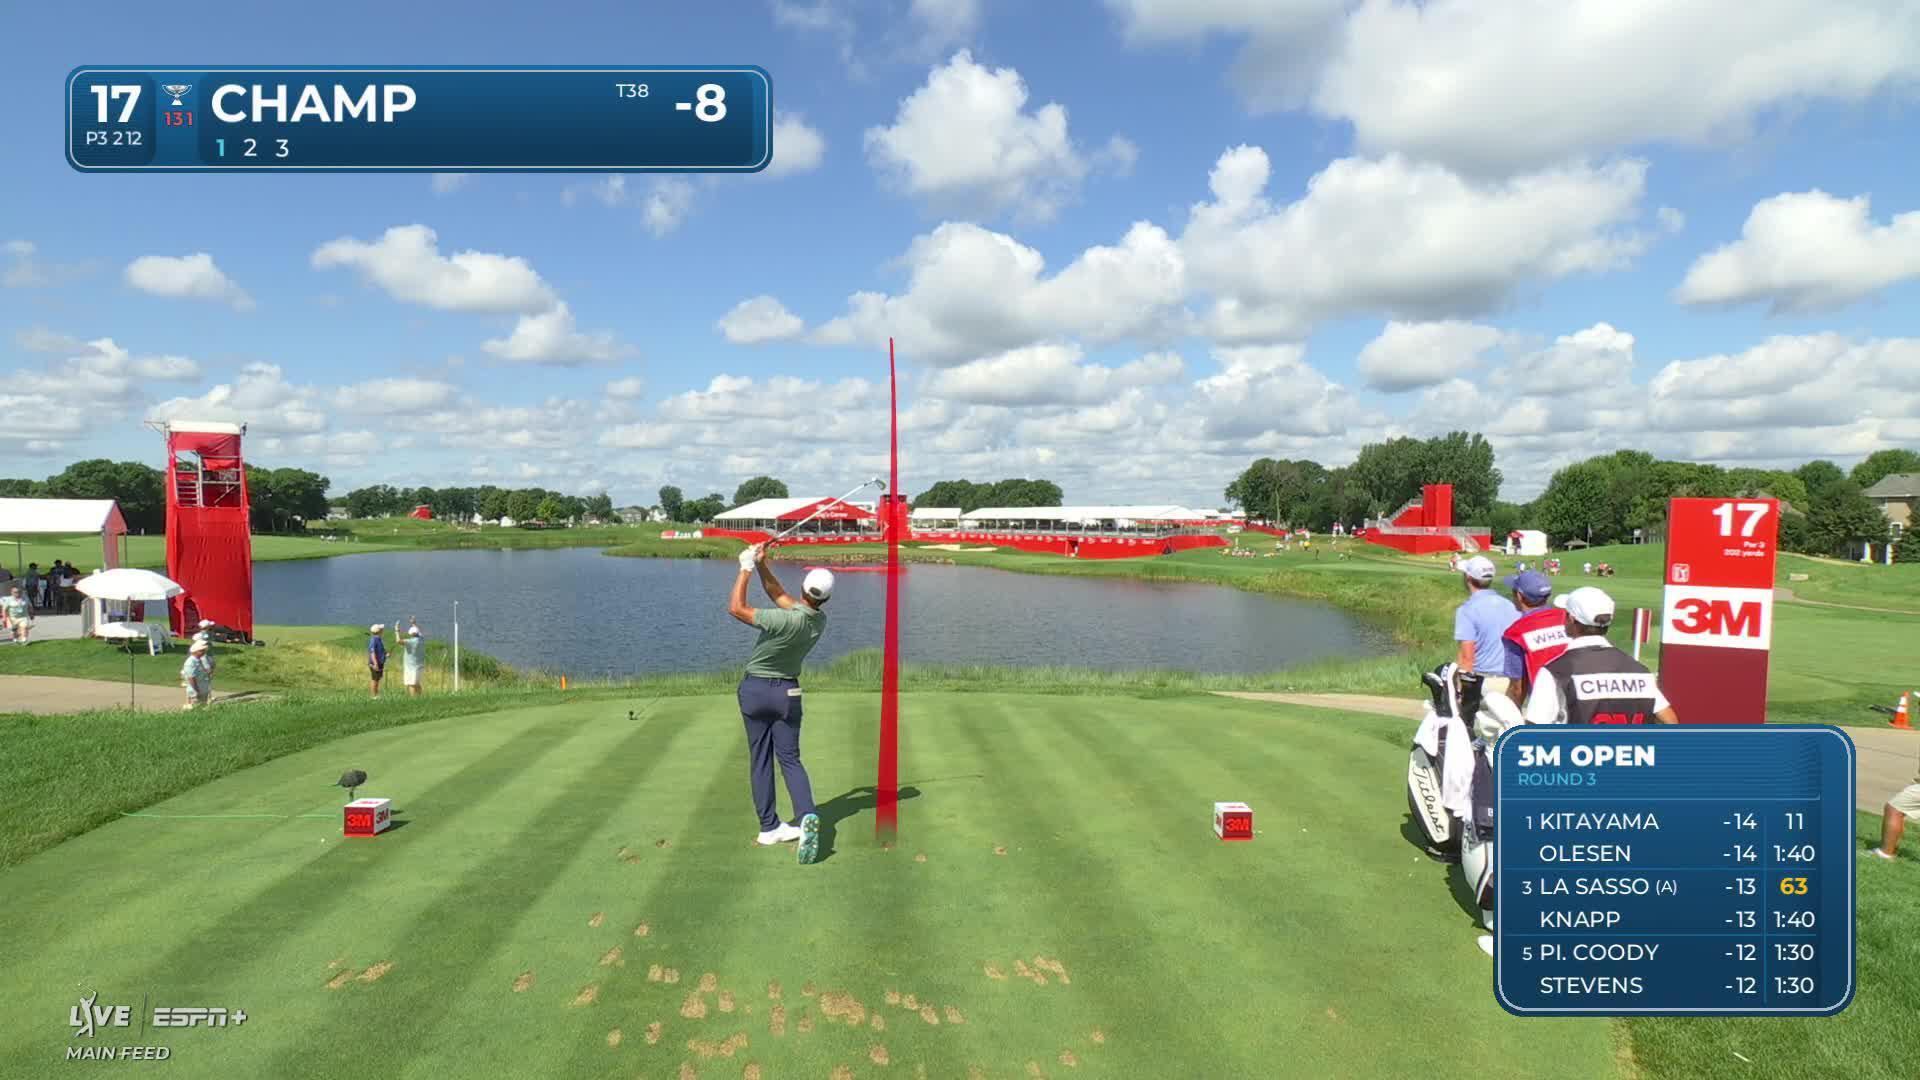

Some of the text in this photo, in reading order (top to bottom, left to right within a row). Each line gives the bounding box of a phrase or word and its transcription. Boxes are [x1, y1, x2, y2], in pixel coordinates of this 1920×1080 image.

[1712, 502, 1769, 537] 17
[1671, 598, 1762, 638] 3M
[1532, 630, 1566, 646] WHA
[1580, 679, 1647, 694] CHAMP
[1412, 766, 1446, 834] Titleist
[347, 814, 371, 827] 3M
[1226, 818, 1250, 831] 3M
